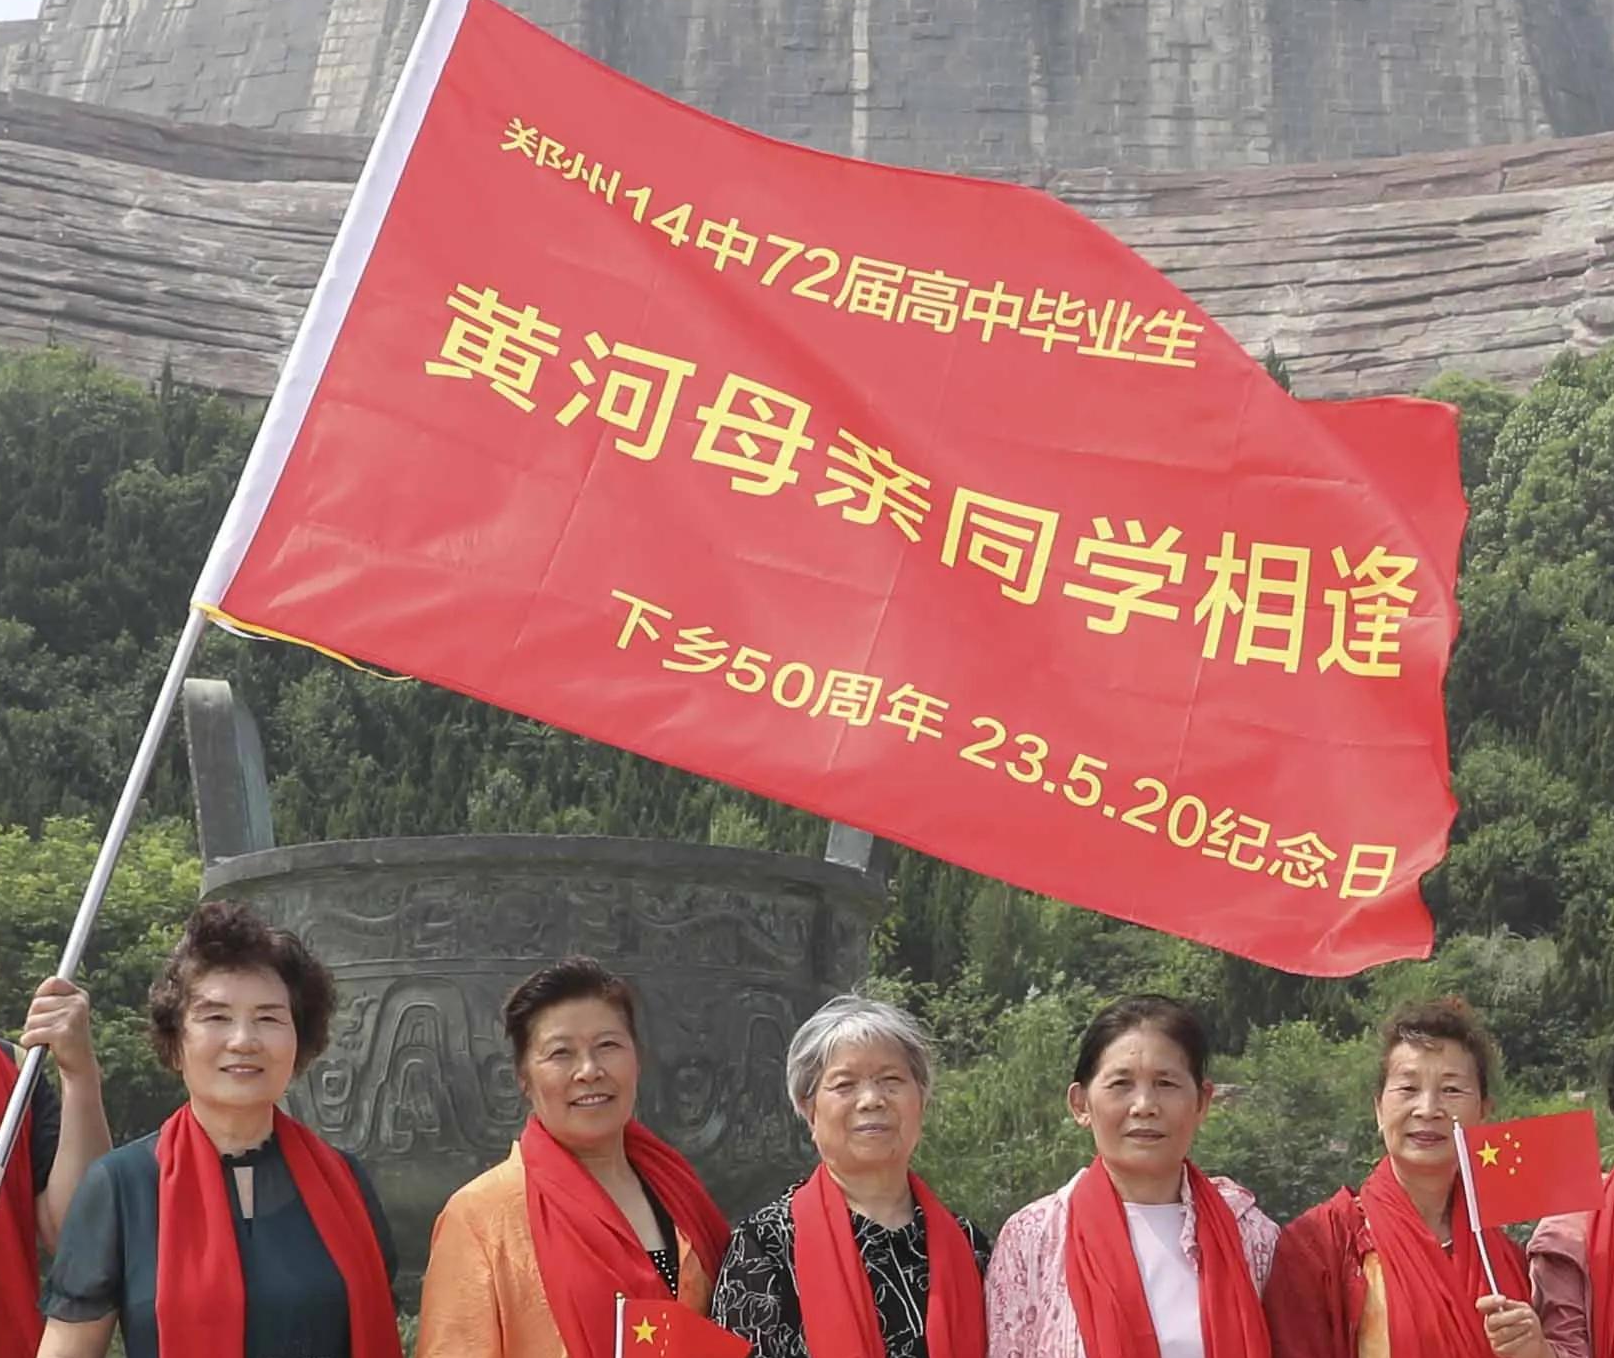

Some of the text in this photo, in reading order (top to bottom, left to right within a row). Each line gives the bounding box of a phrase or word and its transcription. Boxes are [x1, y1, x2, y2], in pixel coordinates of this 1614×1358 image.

[499, 116, 1205, 370] 郑州14中72届高中毕业生
[423, 281, 1420, 679] 黄河母亲同学相逢
[609, 587, 1398, 901] 下乡50周年 23.5.20纪念日
